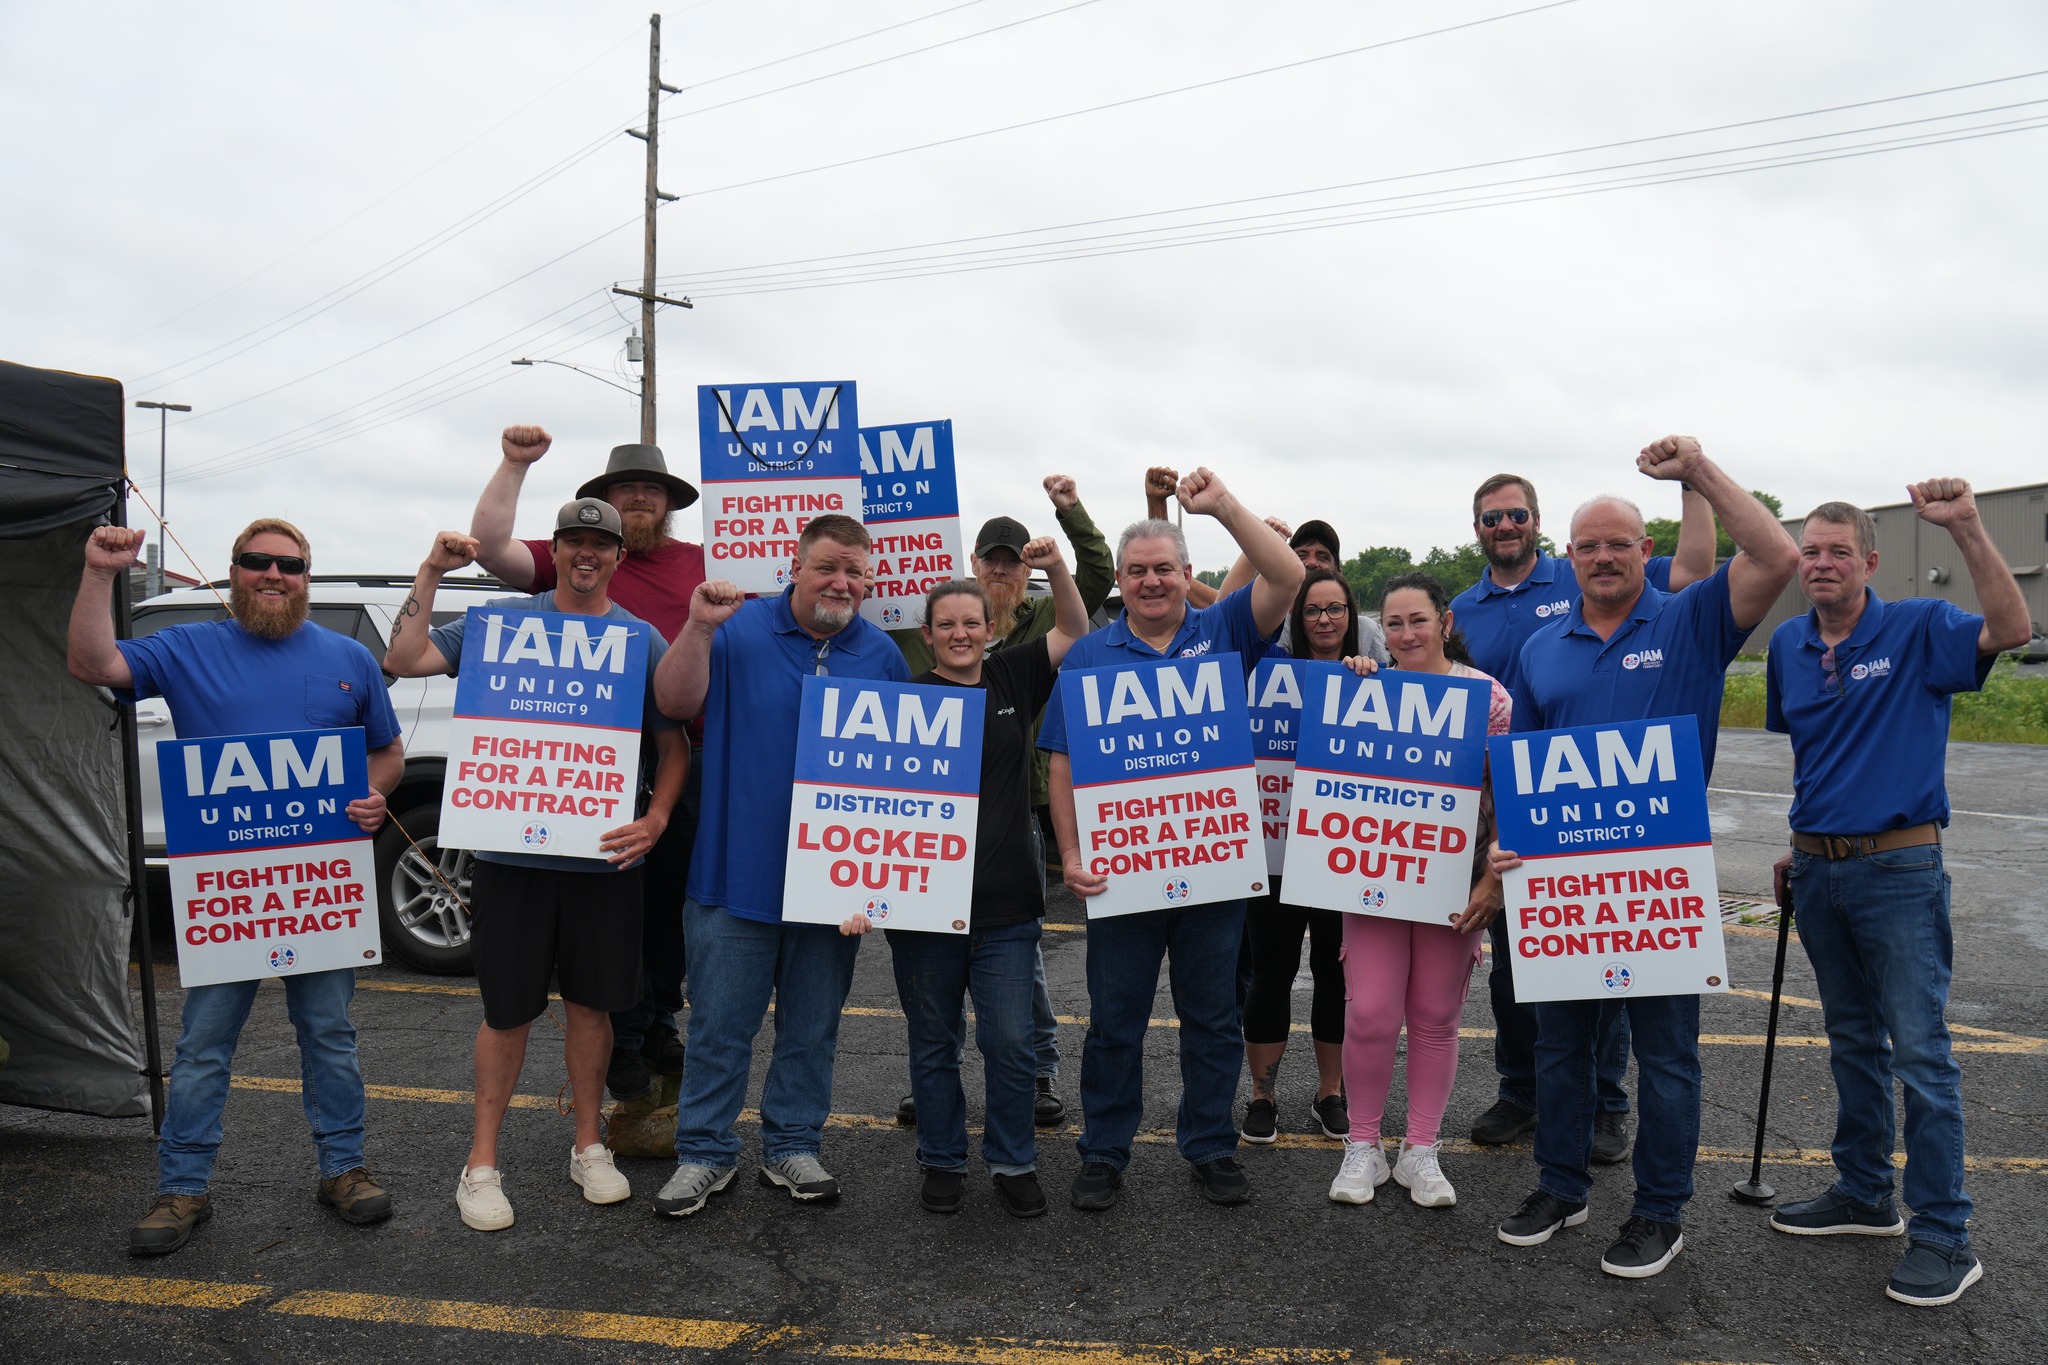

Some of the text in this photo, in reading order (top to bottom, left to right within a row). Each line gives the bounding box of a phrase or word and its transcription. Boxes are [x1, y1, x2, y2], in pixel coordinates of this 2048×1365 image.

[717, 386, 840, 432] IAM
[728, 440, 832, 457] UNION
[748, 461, 814, 472] DISTRICT 9
[722, 494, 843, 514] FIGHTING
[862, 480, 930, 499] ION
[863, 501, 912, 514] STRICT 9
[714, 518, 764, 537] FOR
[772, 518, 789, 535] A
[712, 540, 799, 560] CONTR
[870, 533, 942, 554] HTING
[876, 554, 953, 576] A FAIR
[1551, 600, 1570, 611] IAM
[483, 614, 628, 674] IAM
[1640, 649, 1663, 662] IAM
[1869, 657, 1890, 672] IAM
[490, 675, 612, 700] UNION
[1081, 661, 1225, 727] IAM
[510, 699, 588, 715] DISTRICT 9
[821, 687, 964, 748] IAM
[1322, 674, 1468, 739] IAM
[472, 736, 616, 766] FIGHTING
[1100, 725, 1220, 754] UNION
[1269, 740, 1297, 751] DIST
[1329, 738, 1452, 767] UNION
[183, 735, 345, 797] IAM
[828, 751, 949, 775] UNION
[1125, 751, 1200, 771] DISTRICT 9
[1511, 724, 1677, 795] IAM
[458, 761, 624, 793] FOR A FAIR
[451, 787, 619, 818] CONTRACT
[816, 792, 955, 819] DISTRICT 9
[1097, 787, 1237, 824] FIGHTING
[1315, 779, 1434, 811] DISTRICT
[1441, 794, 1456, 812] 9
[201, 798, 336, 824] UNION
[1530, 796, 1669, 826] UNION
[228, 824, 313, 842] DISTRICT 9
[797, 822, 967, 861] LOCKED
[1091, 825, 1150, 851] FOR
[1157, 821, 1178, 843] A
[1184, 812, 1250, 839] FAIR
[1296, 808, 1467, 854] LOCKED
[1558, 825, 1645, 844] DISTRICT 9
[1090, 839, 1249, 876] CONTRACT
[1327, 846, 1428, 885] OUT!
[196, 859, 352, 892] FIGHTING
[830, 859, 930, 893] OUT!
[1527, 867, 1689, 900] FIGHTING
[187, 883, 364, 919] FOR A FAIR
[1519, 895, 1705, 930] FOR A FAIR
[185, 908, 362, 946] CONTRACT
[1518, 925, 1703, 958] CONTRACT
